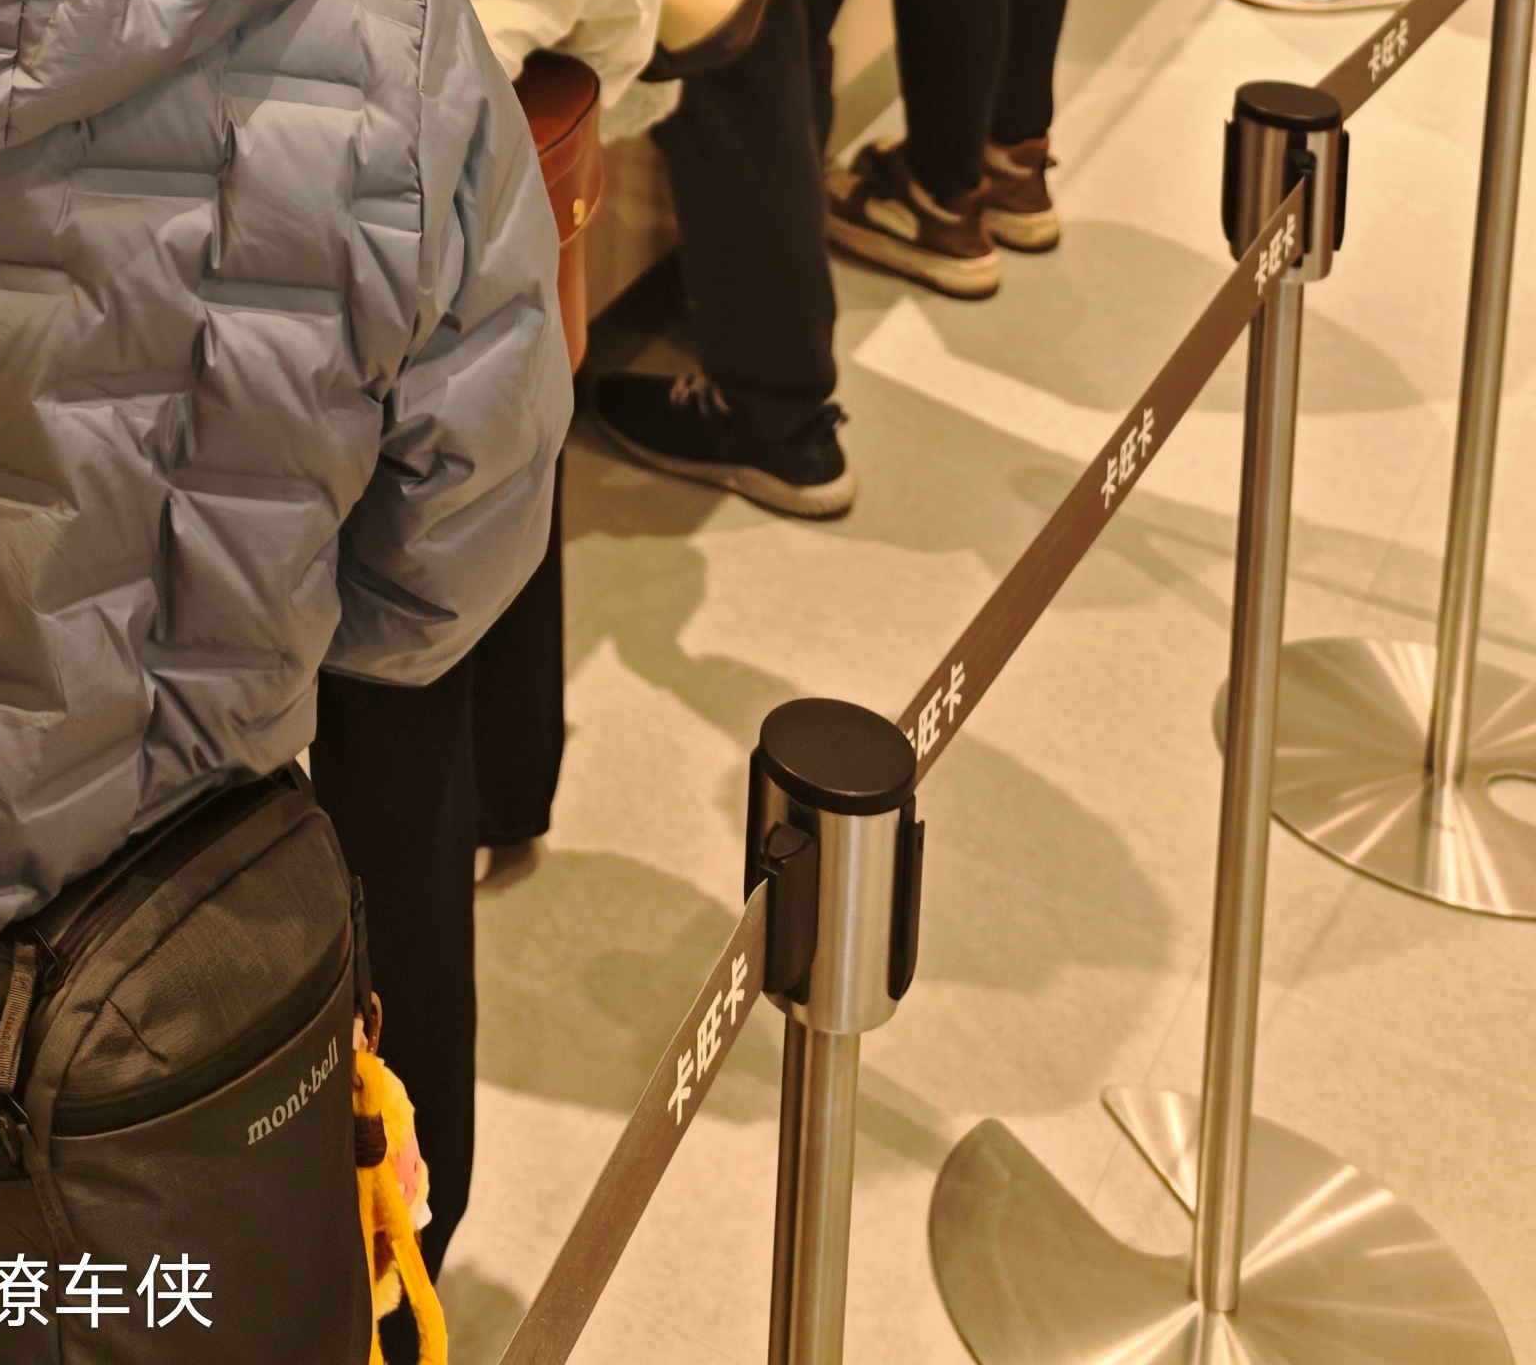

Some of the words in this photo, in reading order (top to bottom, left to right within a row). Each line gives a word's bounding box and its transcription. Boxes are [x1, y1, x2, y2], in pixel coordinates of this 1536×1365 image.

[1368, 18, 1408, 82] 卡旺卡
[1254, 214, 1295, 296] 卡旺卡
[1101, 408, 1153, 509] 卡旺卡
[904, 661, 965, 761] 旺卡
[668, 951, 748, 1126] 卡旺卡
